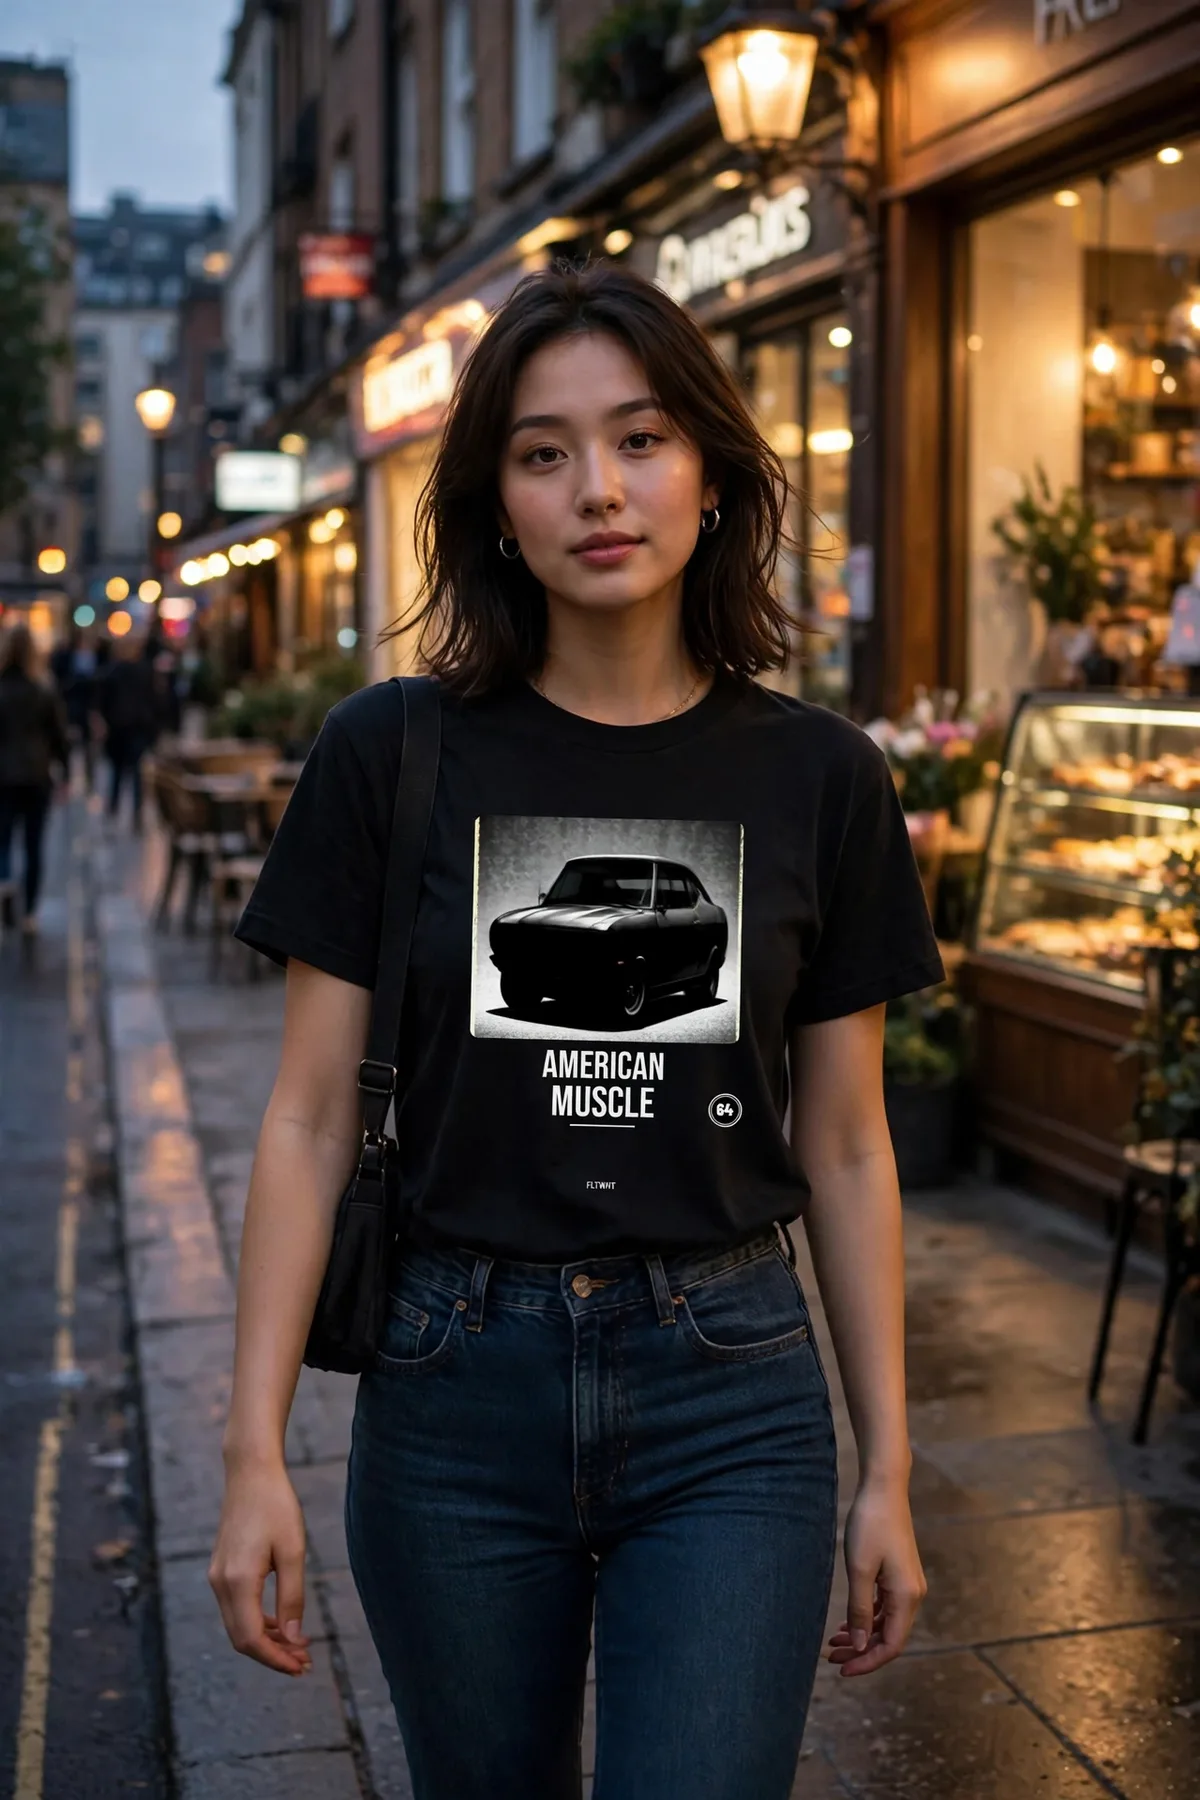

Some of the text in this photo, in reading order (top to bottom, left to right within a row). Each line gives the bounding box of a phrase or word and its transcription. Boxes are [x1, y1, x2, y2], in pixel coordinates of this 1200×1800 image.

[542, 1050, 664, 1080] AMERICAN
[551, 1085, 655, 1118] MUSCLE
[716, 1103, 734, 1116] 64
